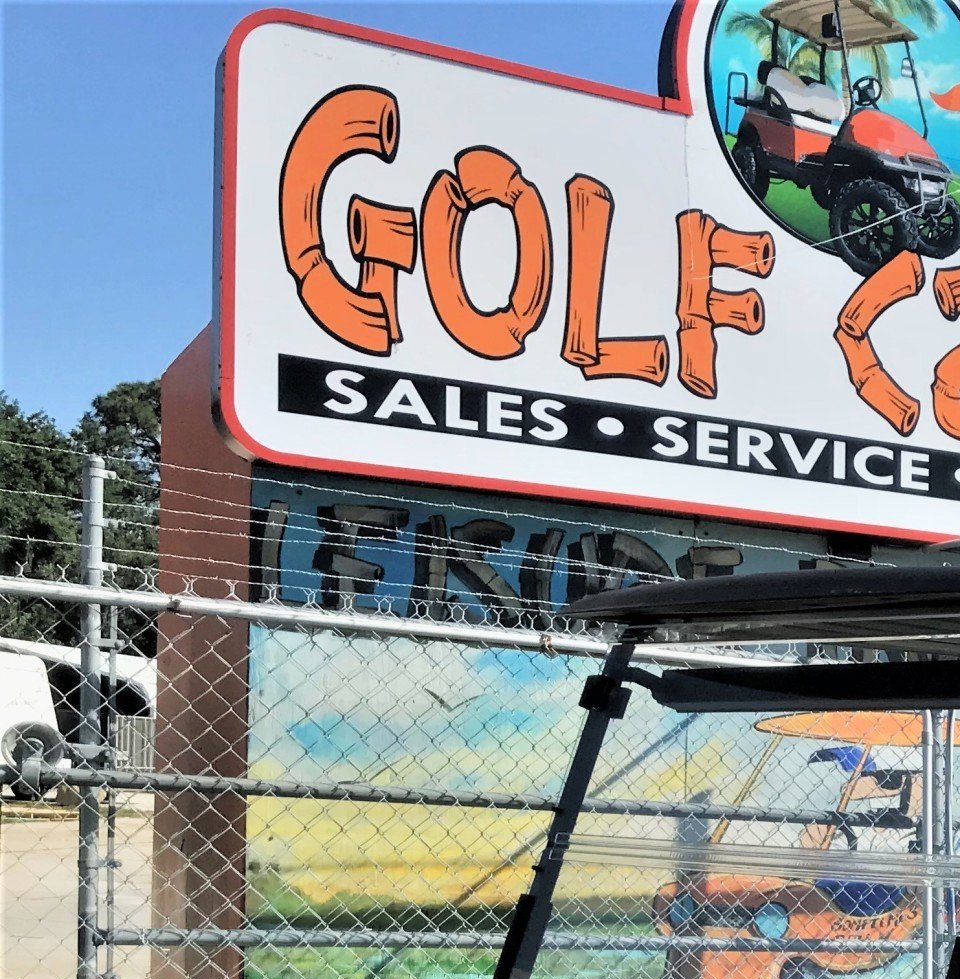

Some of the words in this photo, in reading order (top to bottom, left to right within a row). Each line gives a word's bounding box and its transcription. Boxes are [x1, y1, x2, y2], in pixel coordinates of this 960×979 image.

[278, 83, 776, 399] GOLF
[323, 369, 569, 442] SALES
[650, 415, 931, 492] SERVICE
